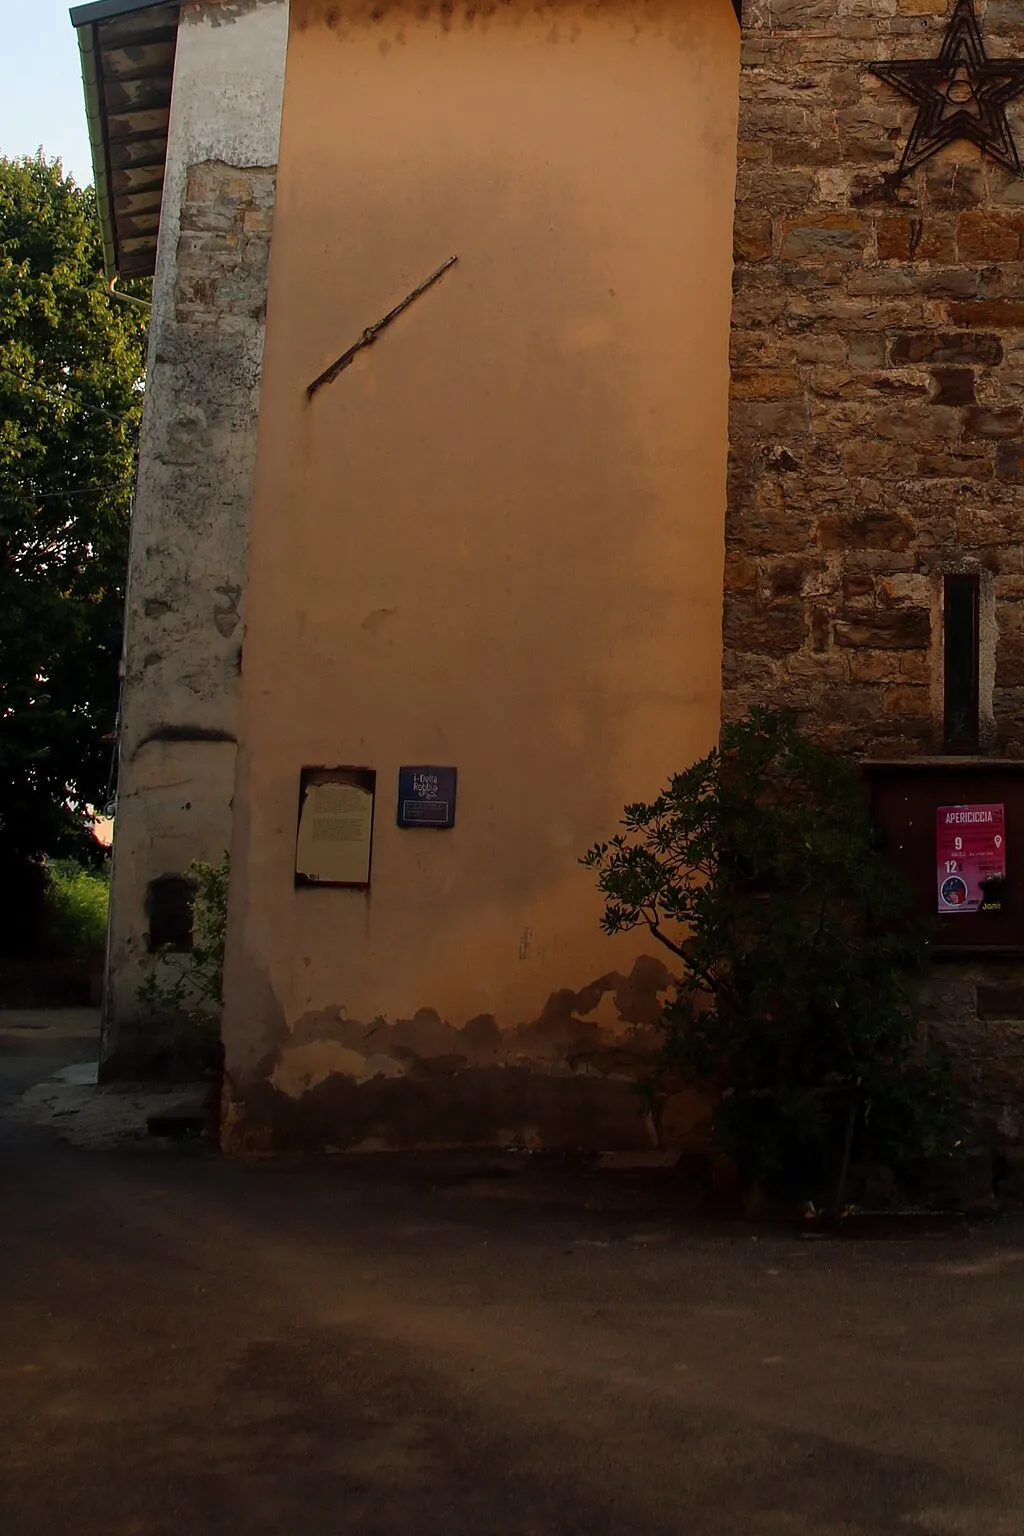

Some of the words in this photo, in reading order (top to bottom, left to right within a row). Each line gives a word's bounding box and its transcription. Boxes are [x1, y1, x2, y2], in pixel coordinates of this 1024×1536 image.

[945, 811, 993, 823] APERICICCIA
[954, 836, 963, 850] 9
[944, 859, 957, 873] 12
